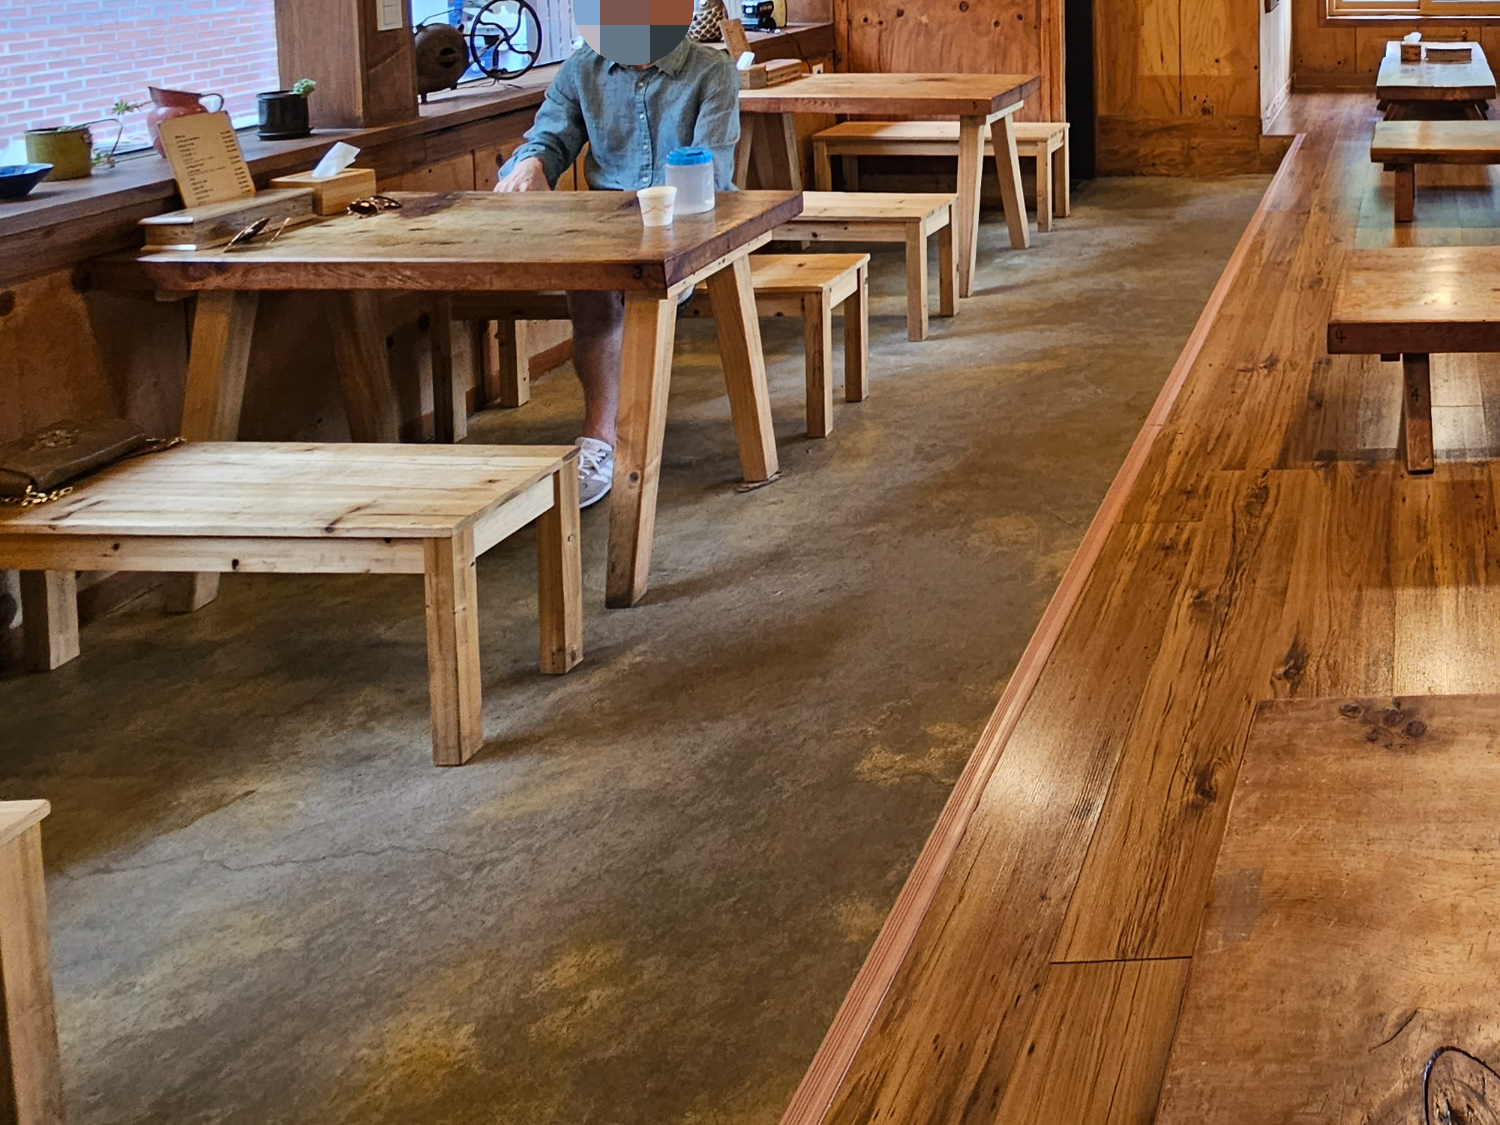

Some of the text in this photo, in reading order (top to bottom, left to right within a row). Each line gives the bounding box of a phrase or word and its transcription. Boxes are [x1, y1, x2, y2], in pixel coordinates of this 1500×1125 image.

[633, 265, 644, 280] 3
[1335, 328, 1347, 343] 4
[1410, 388, 1421, 403] 4
